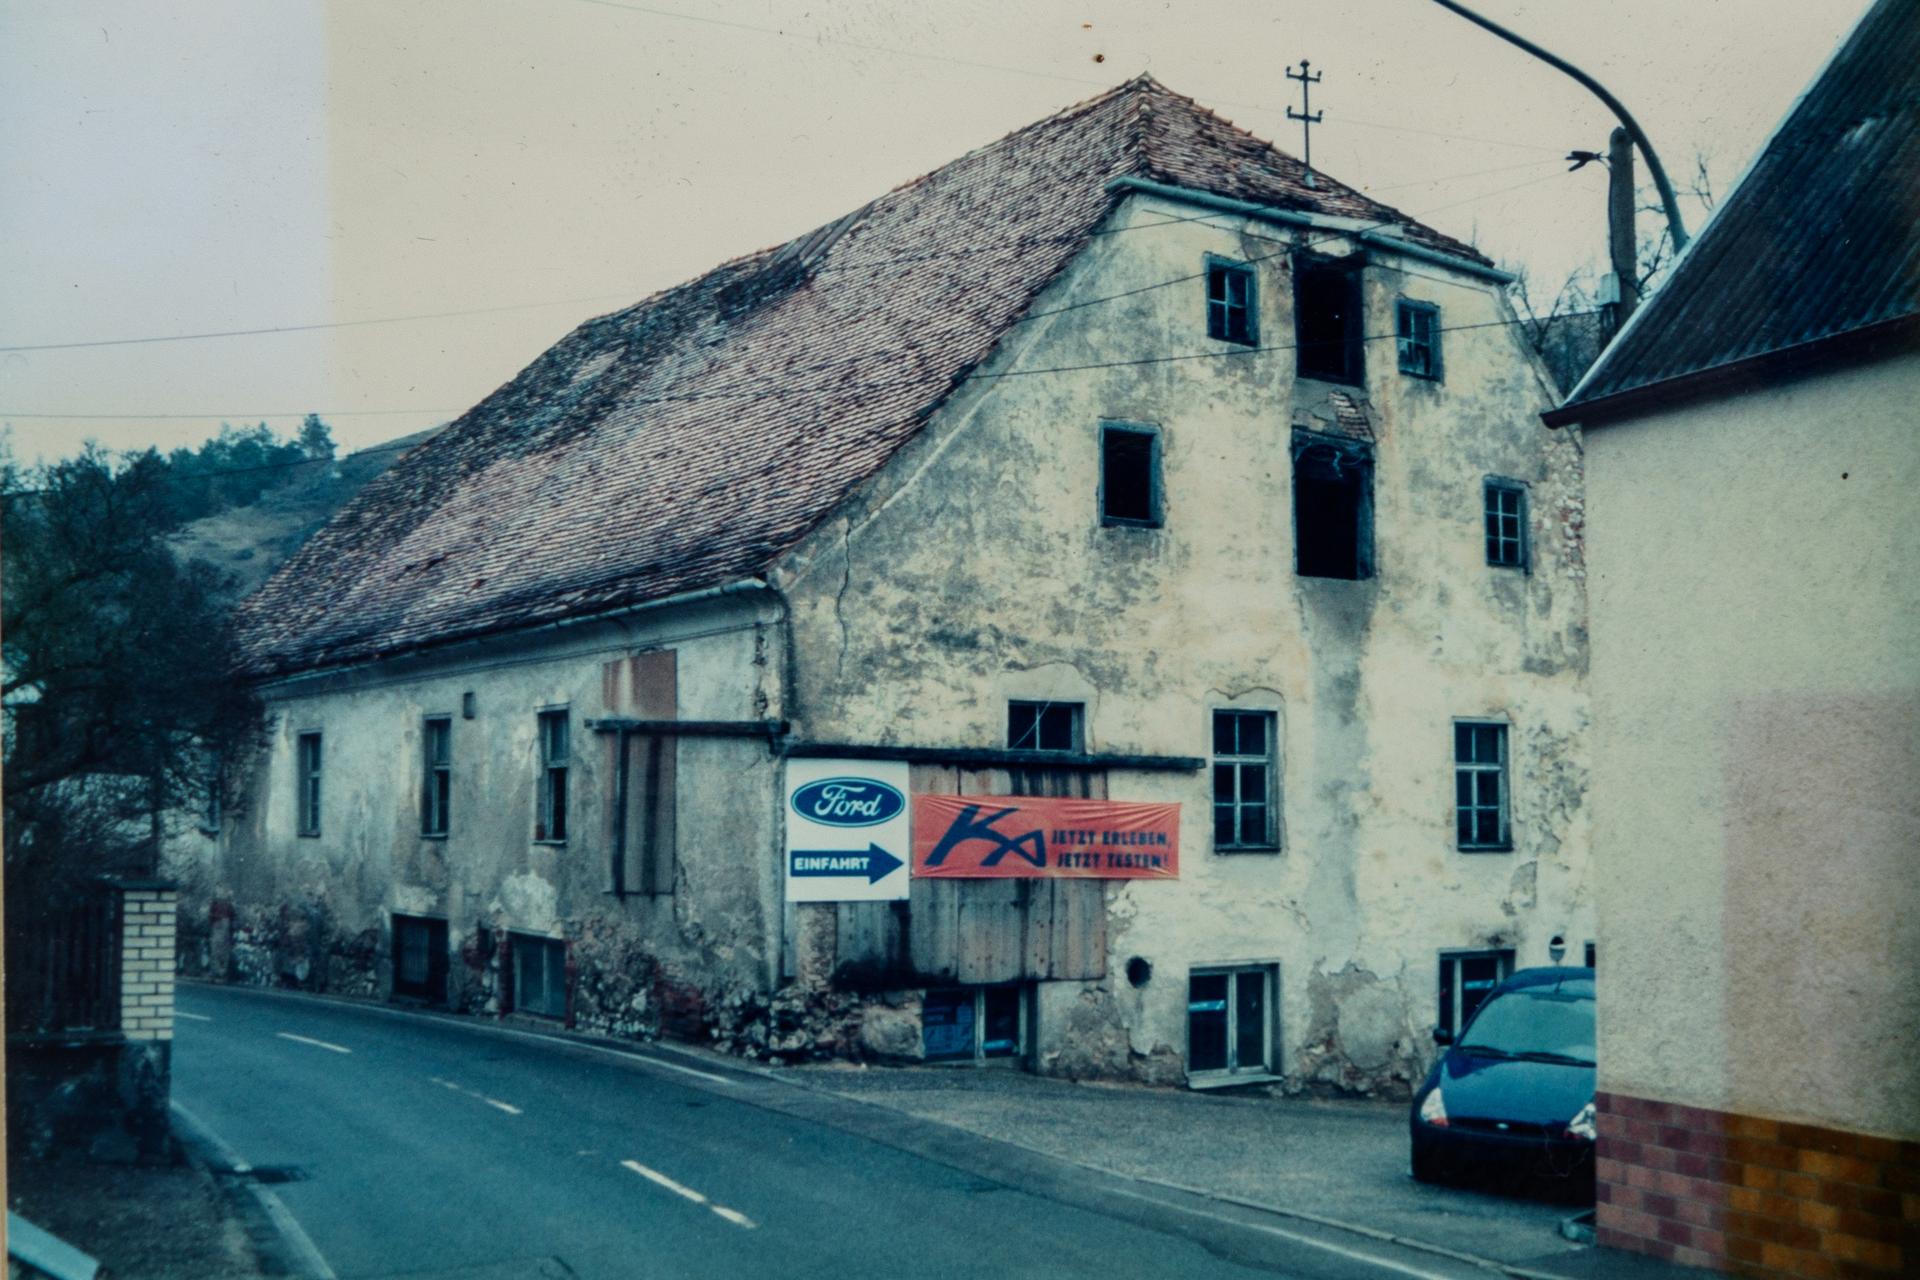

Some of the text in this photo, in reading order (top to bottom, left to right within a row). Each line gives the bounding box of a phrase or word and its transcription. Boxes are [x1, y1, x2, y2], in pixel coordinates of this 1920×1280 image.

[815, 784, 881, 817] Ford
[1052, 830, 1172, 848] JETZT ERLEBEN,
[794, 857, 871, 870] EINFAHRT
[1057, 852, 1168, 868] JETZT TESTEN!
